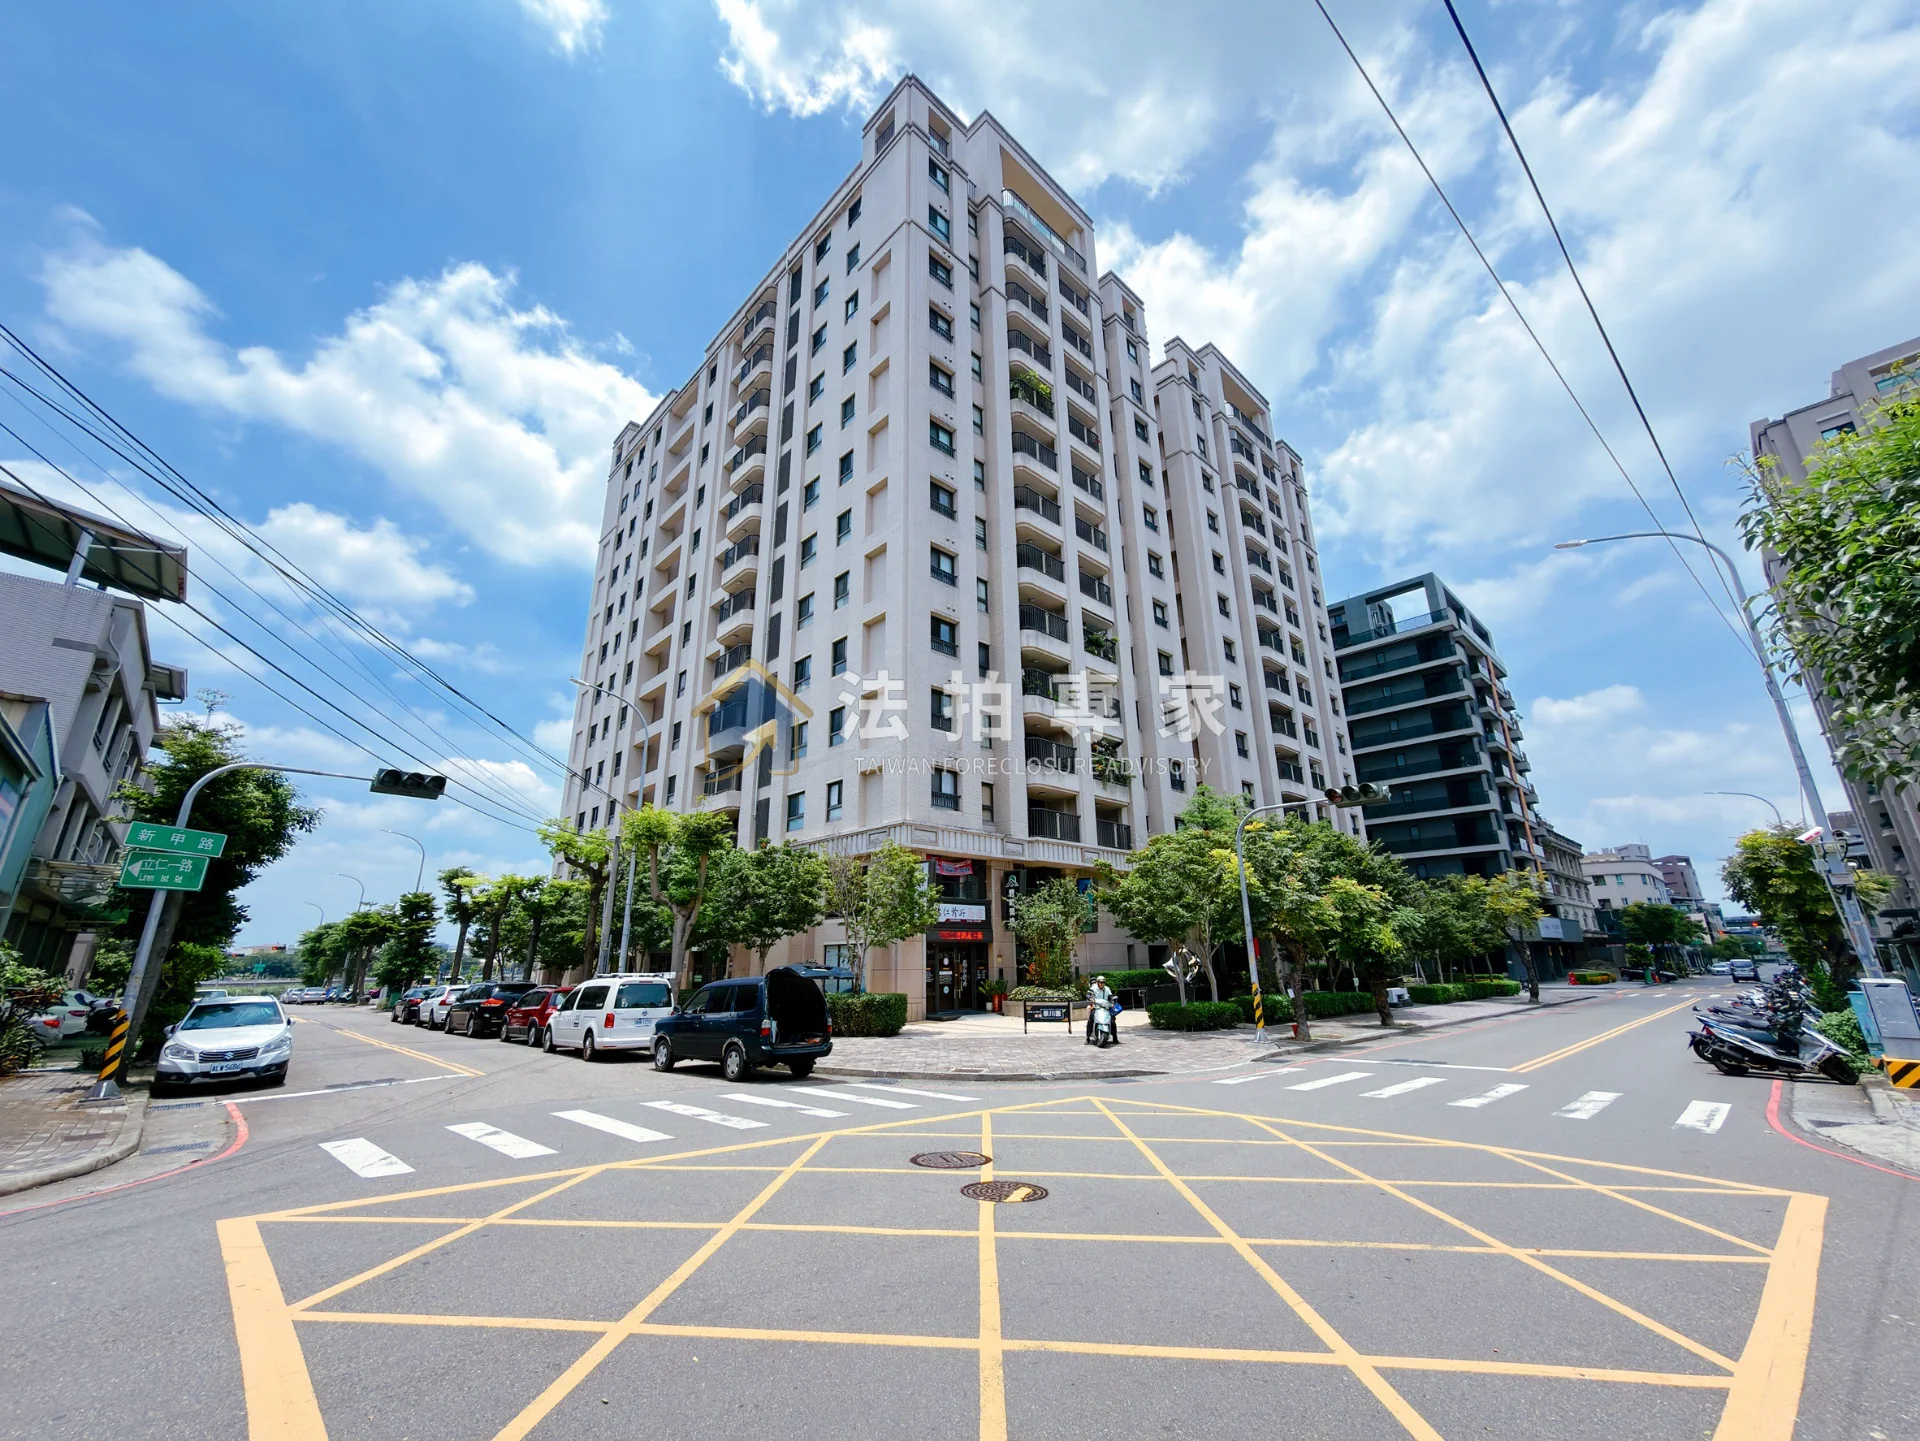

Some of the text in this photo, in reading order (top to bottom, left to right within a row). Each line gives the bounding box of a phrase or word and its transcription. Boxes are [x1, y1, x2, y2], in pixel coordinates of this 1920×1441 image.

[137, 828, 214, 850] 新甲路
[141, 857, 193, 873] 立仁一路
